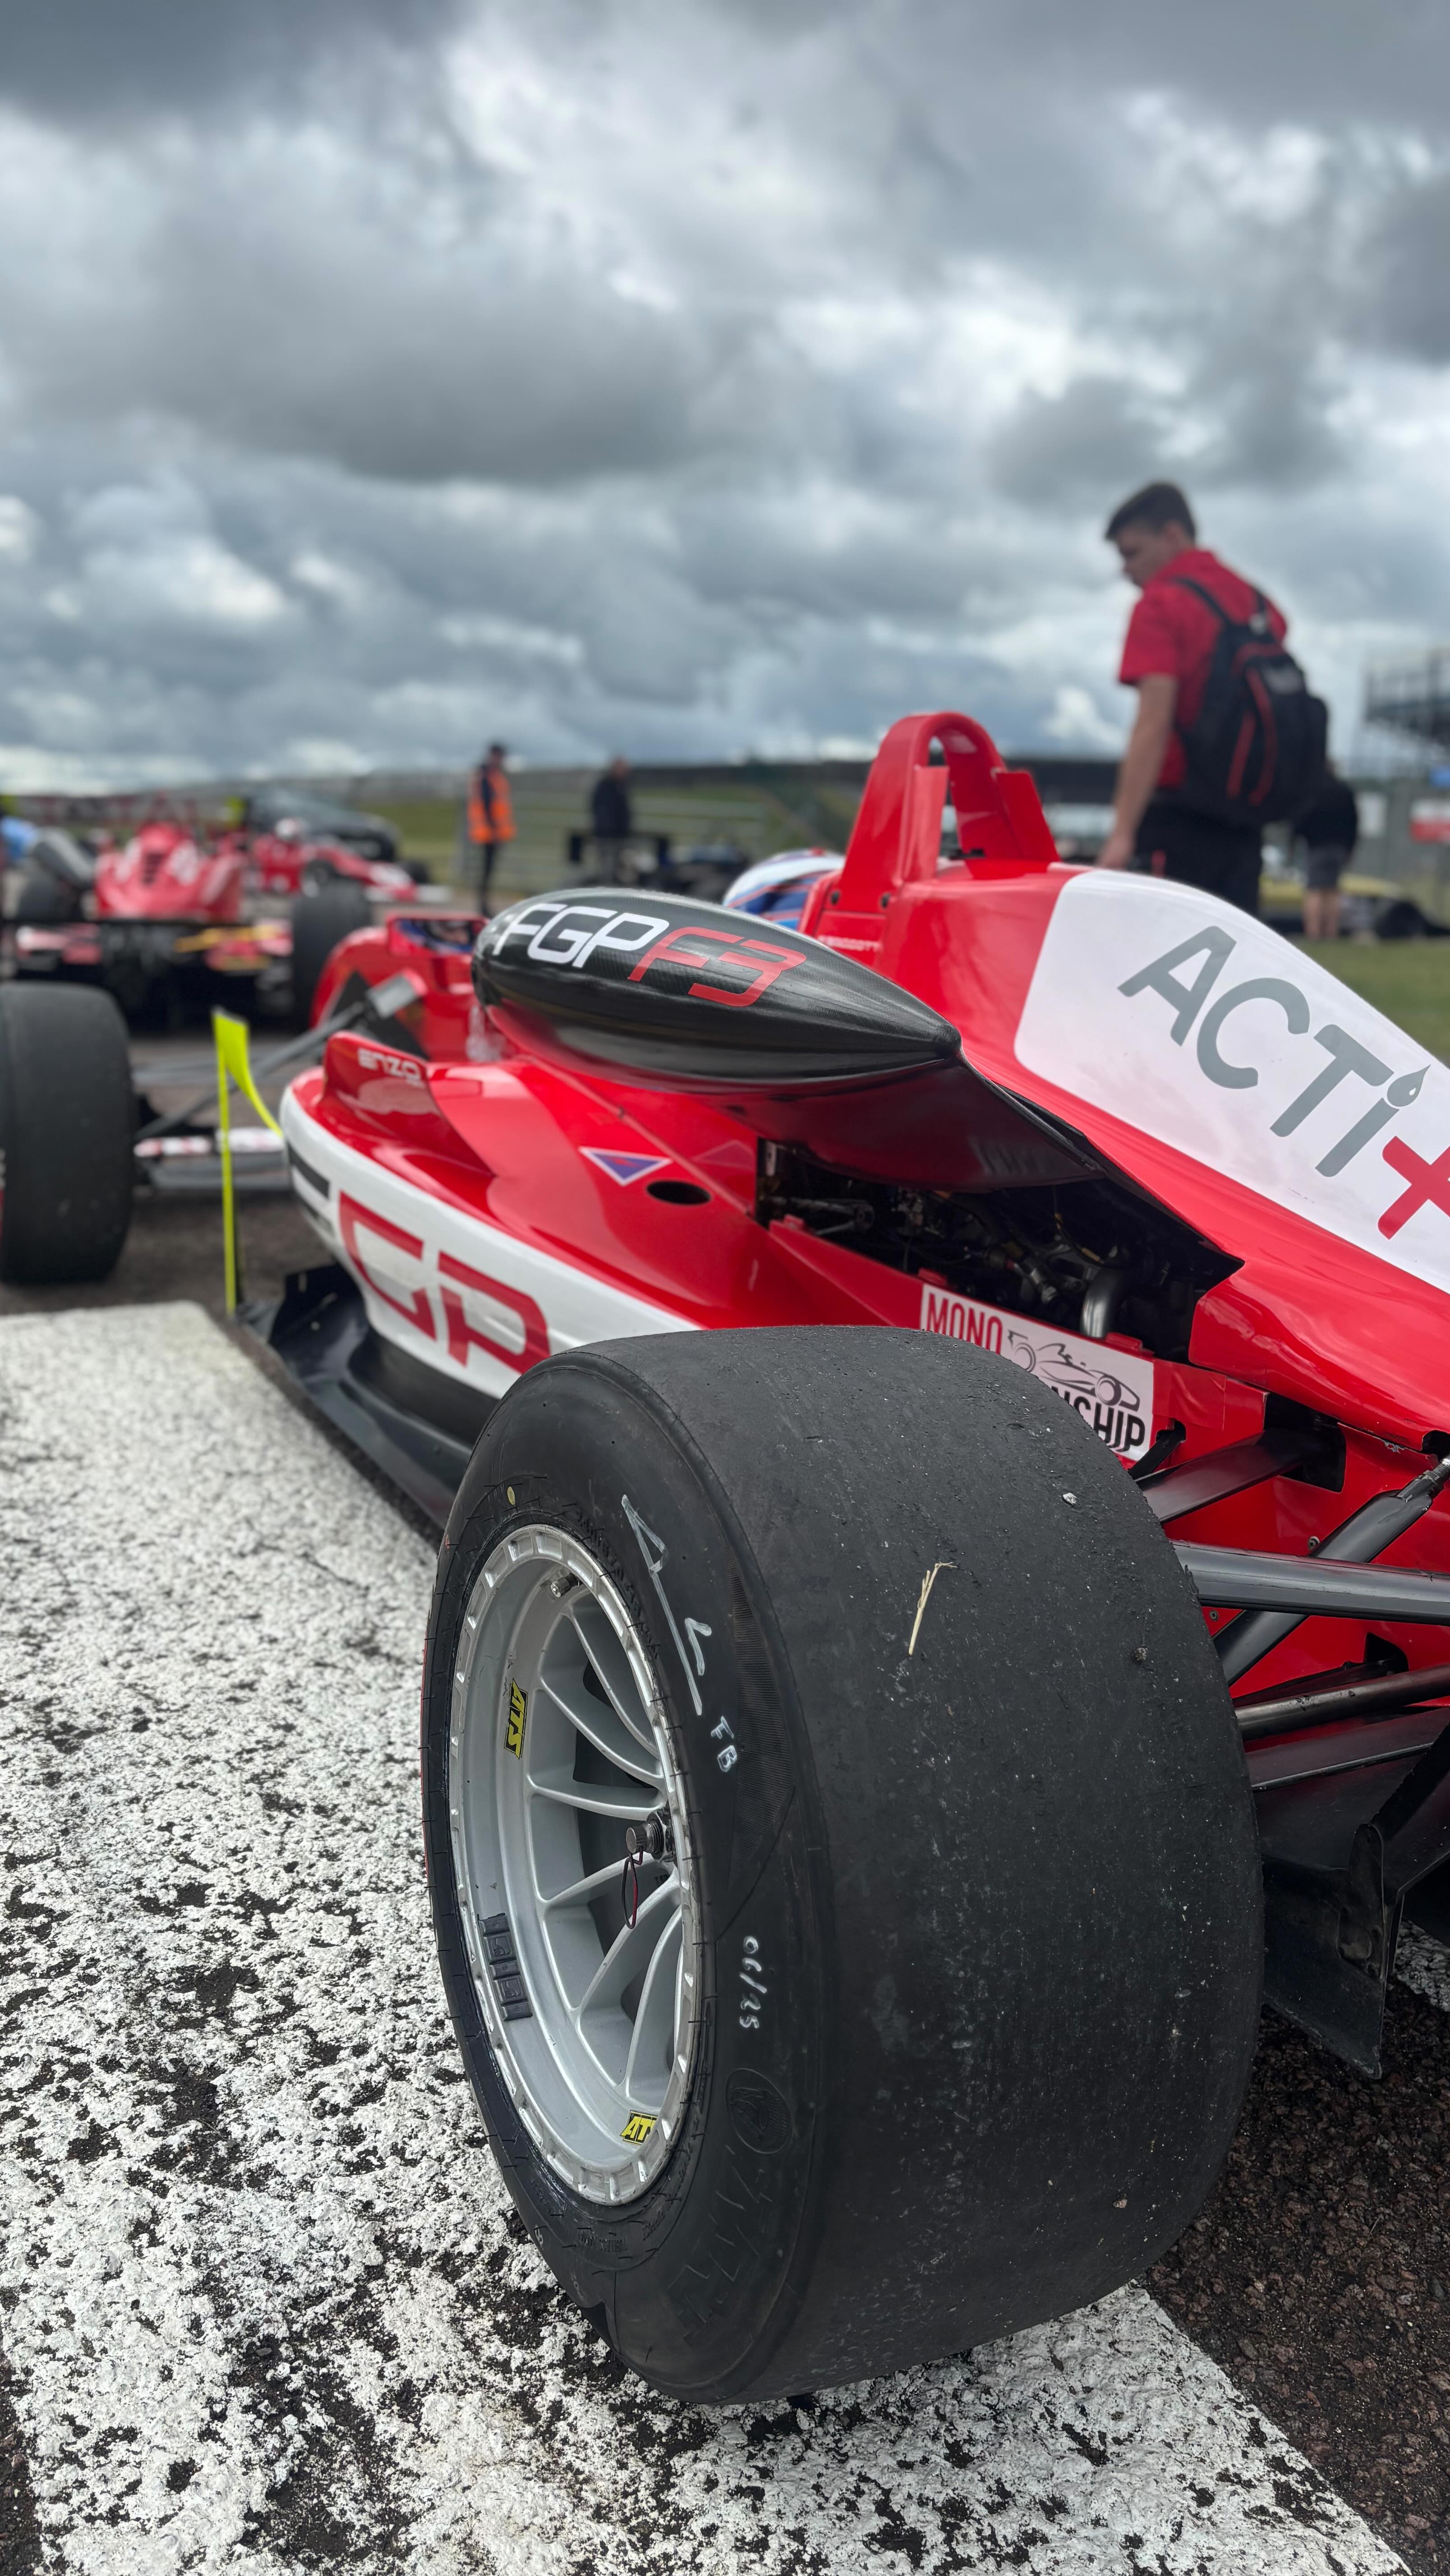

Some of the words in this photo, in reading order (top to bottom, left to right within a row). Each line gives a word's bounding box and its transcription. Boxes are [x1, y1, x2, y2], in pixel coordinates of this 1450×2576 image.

[492, 903, 670, 968] FGP
[628, 926, 807, 1007] F3
[927, 1293, 1003, 1356] MONO
[508, 1678, 525, 1760] ATS
[711, 1716, 737, 1772] FB
[739, 1935, 767, 2029] 06/25
[619, 2115, 656, 2141] AT
